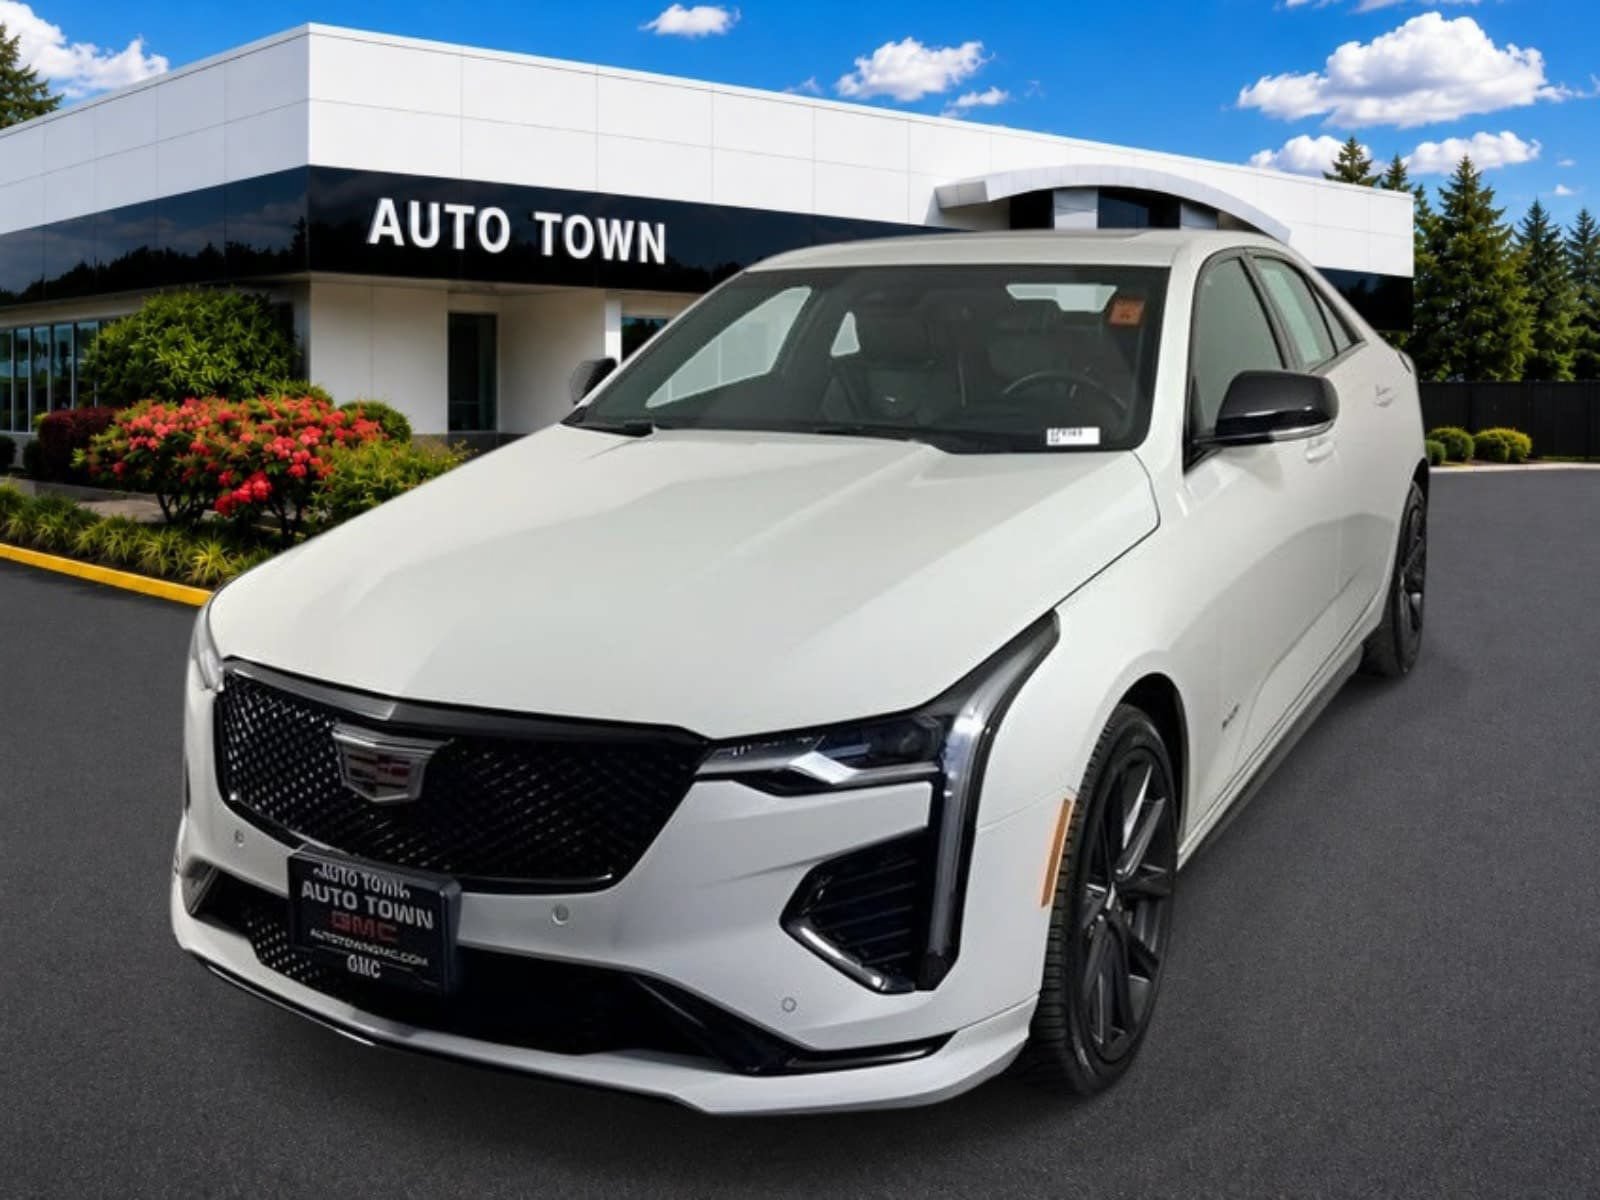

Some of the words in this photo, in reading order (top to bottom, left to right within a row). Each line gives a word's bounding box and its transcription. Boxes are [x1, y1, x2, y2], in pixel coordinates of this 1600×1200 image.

[367, 197, 511, 254] AUTO
[533, 211, 667, 265] TOWN
[301, 880, 357, 909] AUTO
[364, 895, 434, 930] TOWN
[330, 911, 398, 942] GMC
[347, 954, 381, 978] GMC
